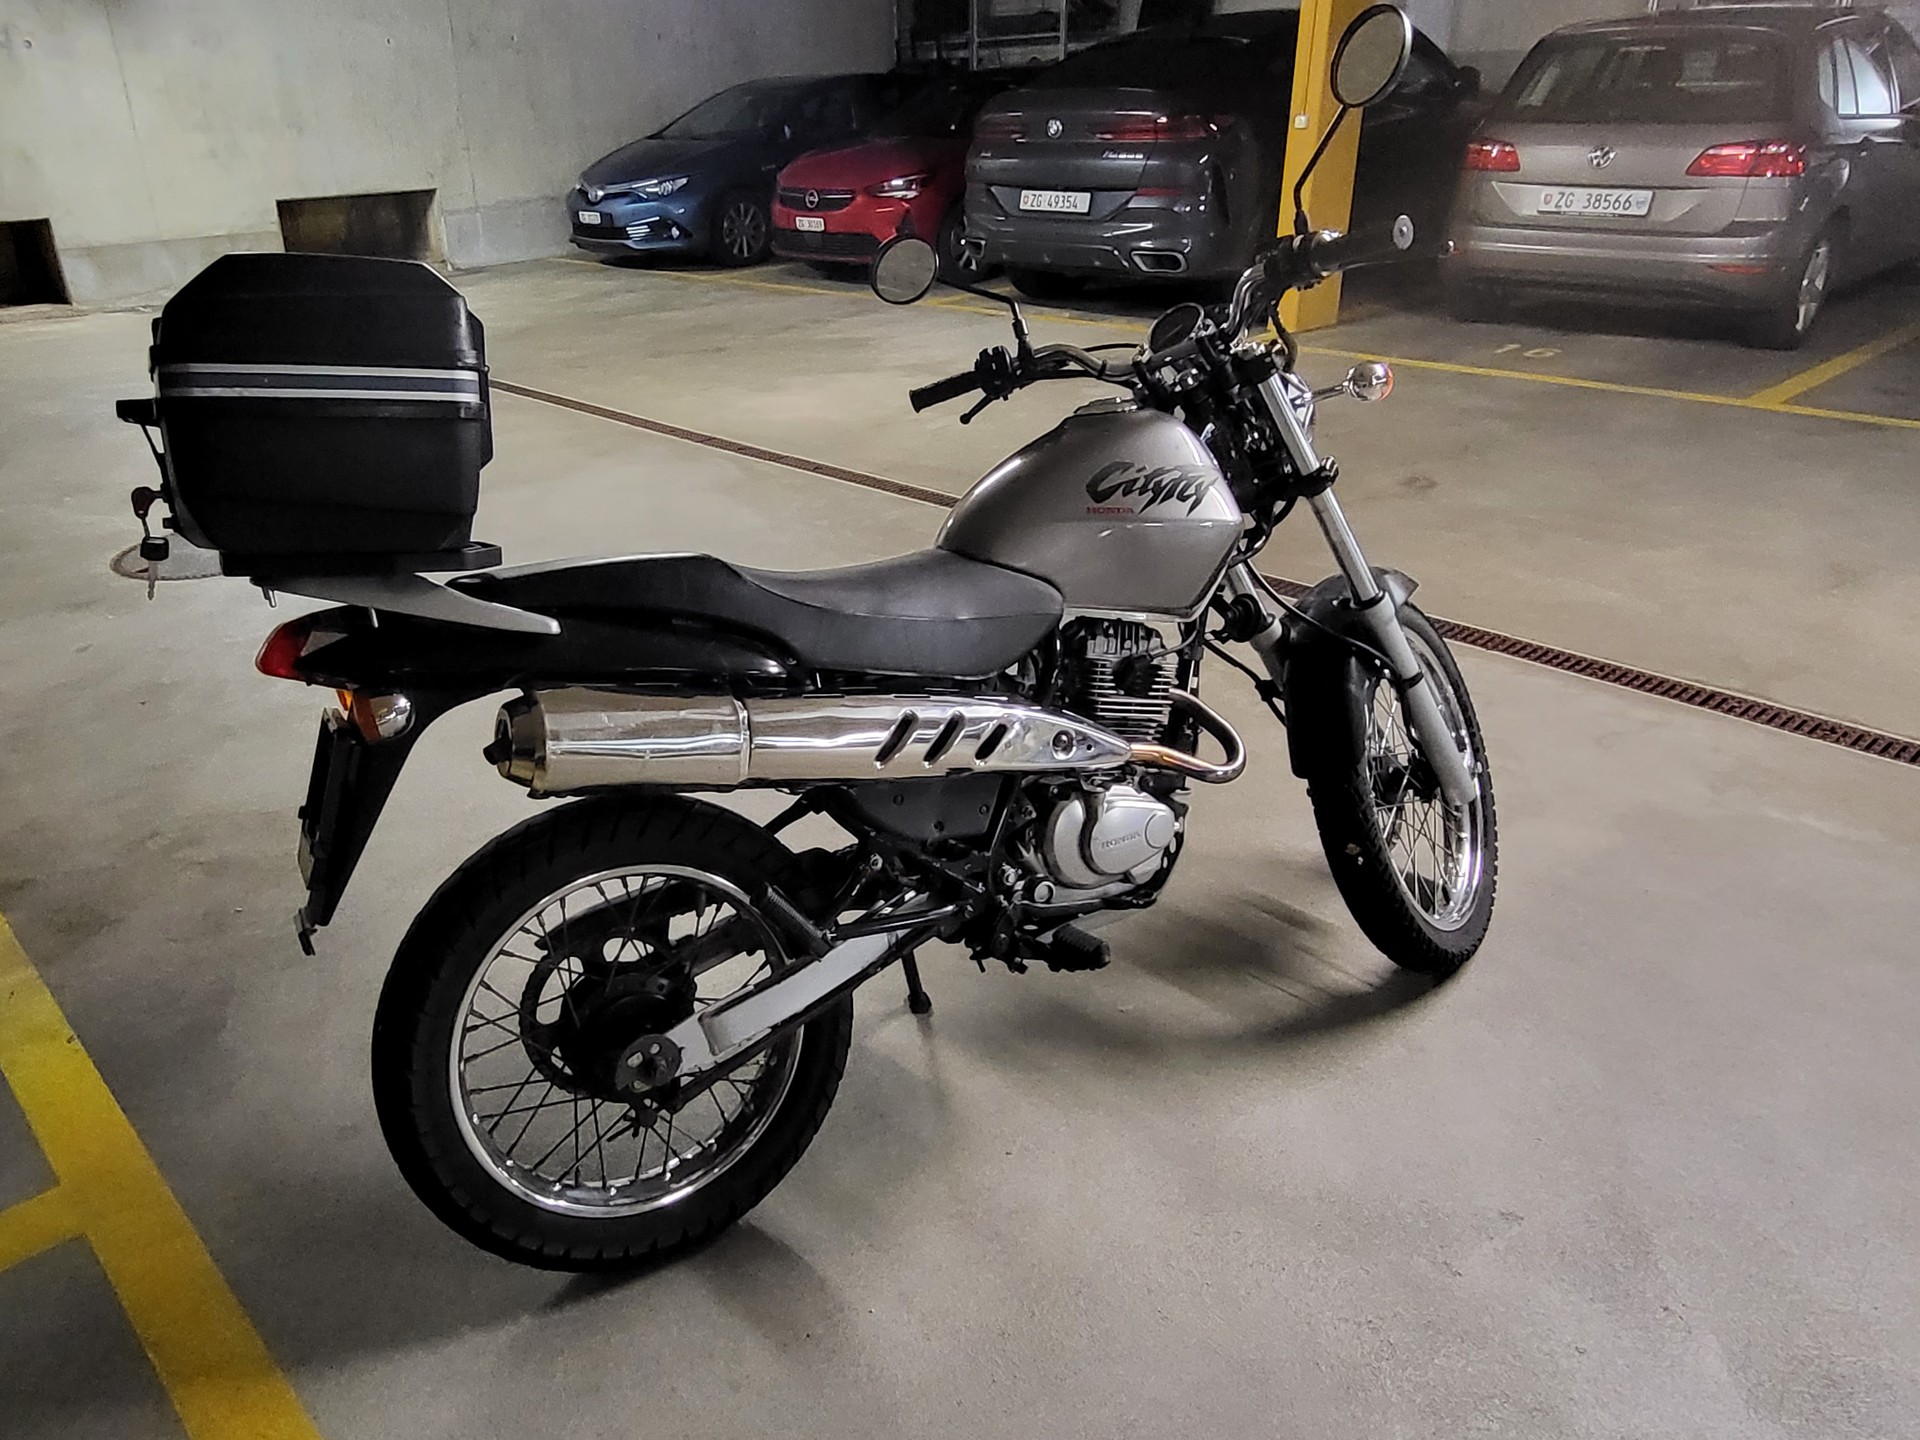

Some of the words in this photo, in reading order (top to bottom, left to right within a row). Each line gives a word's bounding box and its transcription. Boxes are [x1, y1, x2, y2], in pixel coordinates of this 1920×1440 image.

[1031, 194, 1042, 207] ZG
[1047, 195, 1078, 209] 49354
[1554, 192, 1575, 208] ZG
[1582, 193, 1632, 210] 38566
[1086, 506, 1135, 515] HONDA
[1101, 831, 1142, 849] HONDA
